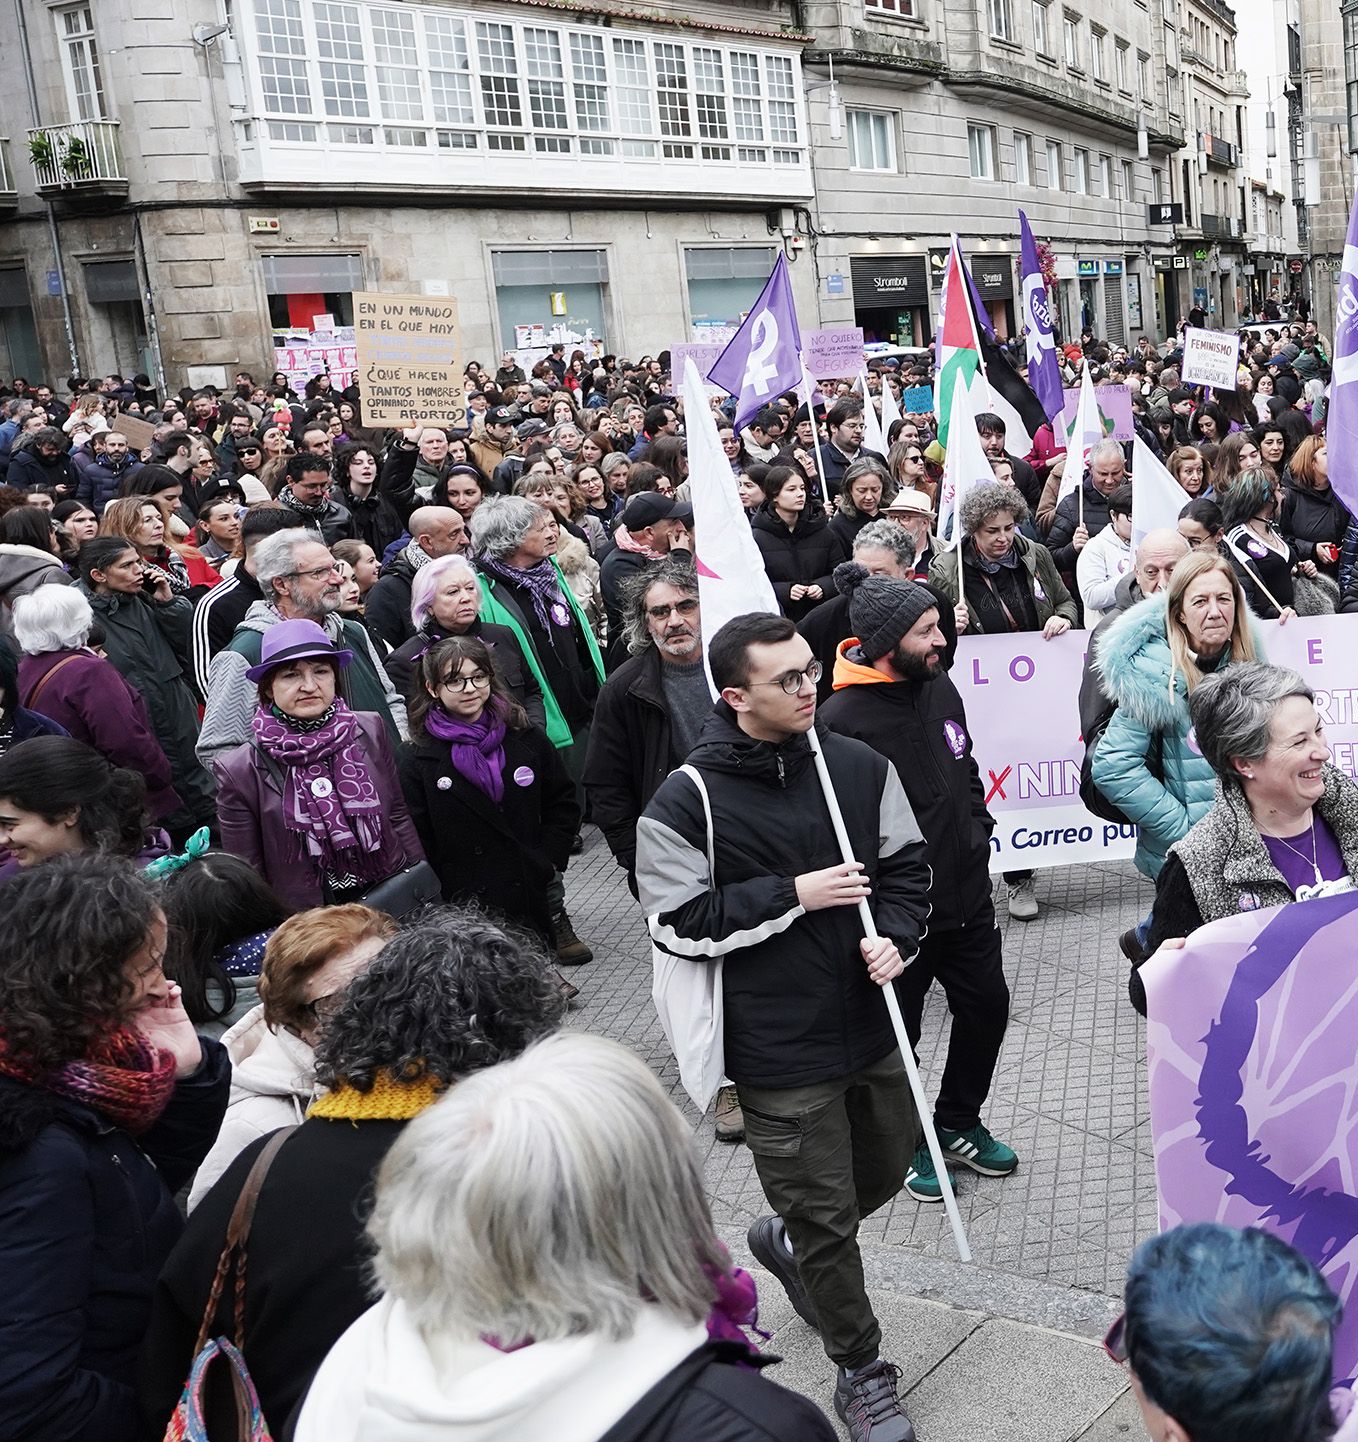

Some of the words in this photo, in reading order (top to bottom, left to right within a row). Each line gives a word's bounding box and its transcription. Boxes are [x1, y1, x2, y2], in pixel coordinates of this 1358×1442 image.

[359, 302, 377, 314] EN
[383, 305, 404, 316] UN
[409, 306, 453, 319] MUNDO
[359, 319, 376, 330] EN
[380, 320, 393, 330] EL
[398, 321, 423, 332] QUE
[429, 323, 454, 335] HAY
[811, 334, 827, 346] NO
[830, 333, 863, 344] QUIERO
[1190, 338, 1233, 357] FEMINISMO
[676, 348, 708, 360] GIRLS
[815, 357, 865, 373] SEGURAS
[408, 370, 448, 381] HACEN
[368, 385, 412, 397] TANTOS
[416, 387, 461, 397] HOMBRES
[366, 399, 415, 408] OPINANDO
[422, 399, 457, 407] SOBRE
[370, 410, 387, 419] EL
[399, 408, 466, 428] ABORTO?
[1011, 826, 1093, 850] Correo
